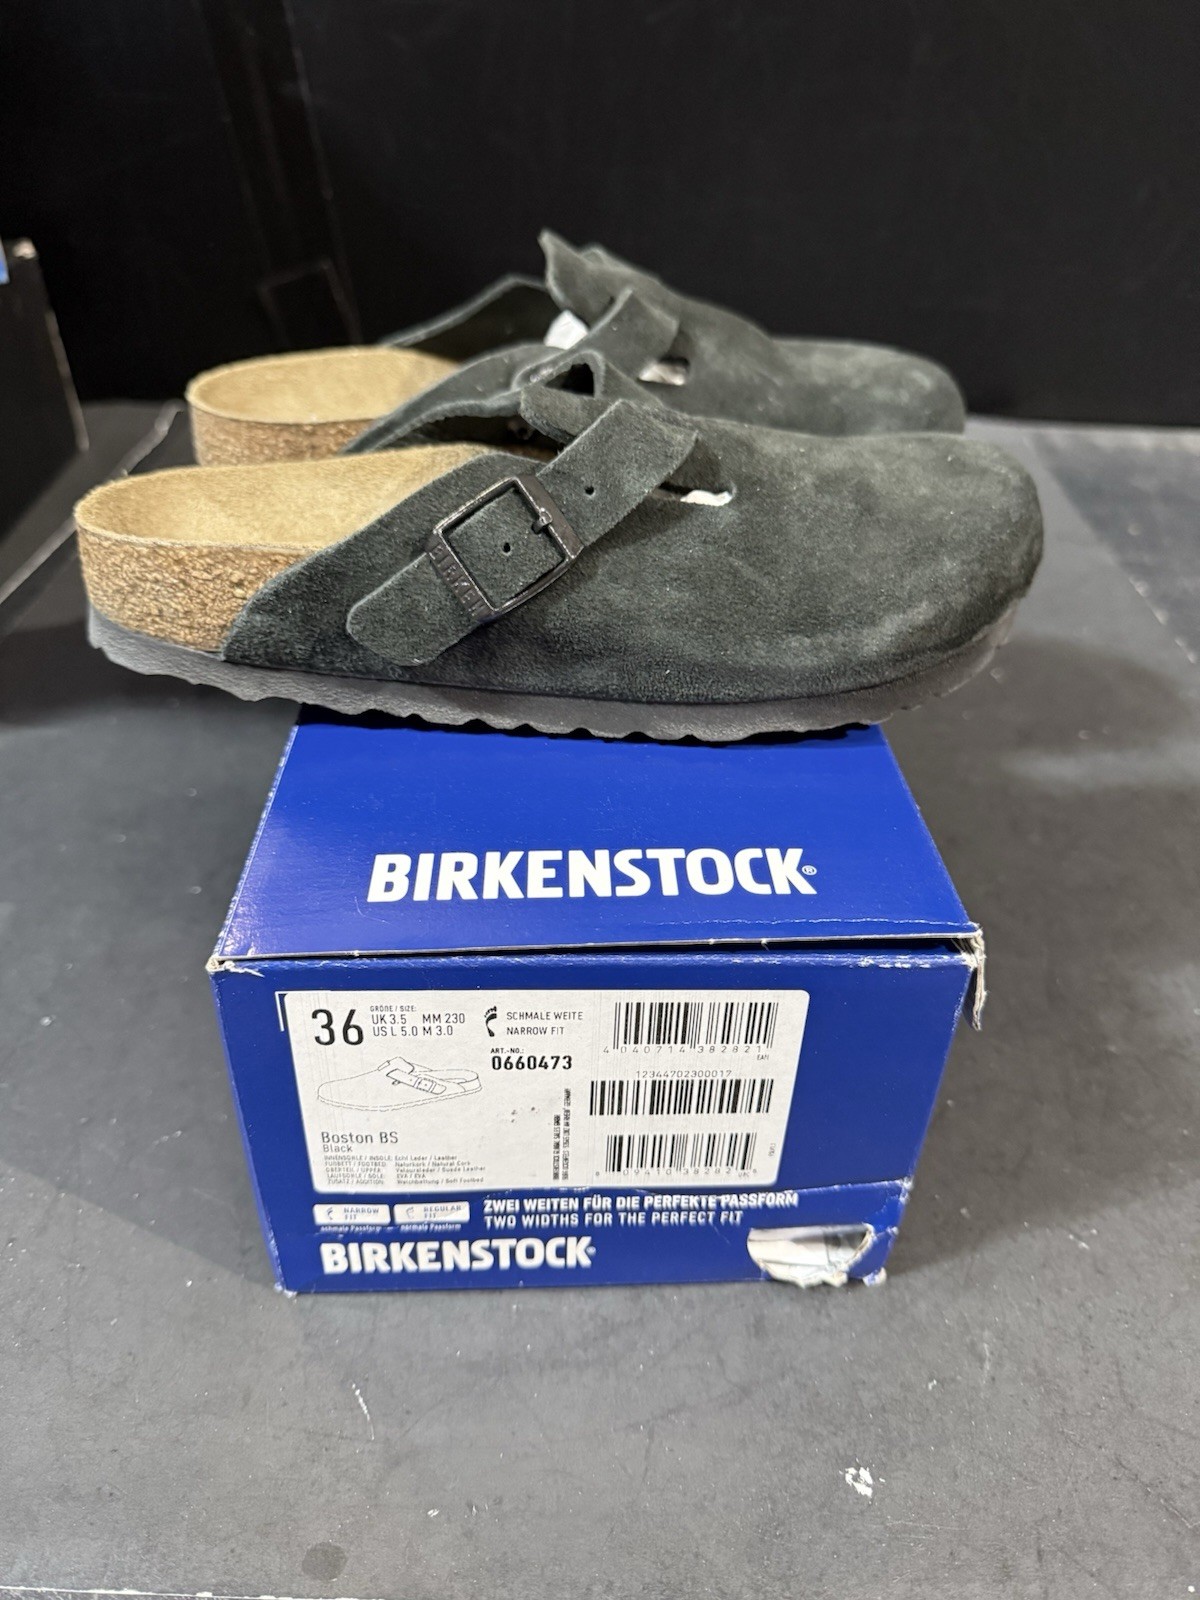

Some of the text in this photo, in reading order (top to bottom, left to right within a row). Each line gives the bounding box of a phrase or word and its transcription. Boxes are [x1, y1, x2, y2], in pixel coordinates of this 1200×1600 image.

[371, 1013, 466, 1025] UK 3.5 MM 230
[506, 1011, 584, 1021] SCHMALE WEITE
[311, 1008, 364, 1046] 36
[373, 1025, 454, 1037] US L 5.0 M 3.0
[506, 1026, 565, 1036] NARROW FIT
[602, 1046, 610, 1054] 4
[491, 1055, 573, 1071] 0660473
[636, 1069, 732, 1079] 12344702300017
[321, 1131, 399, 1144] Boston BS
[322, 1143, 353, 1153] Black
[484, 1190, 799, 1213] ZWEI WEITEN FÜR DIE PERFEKTE PASSFORM
[485, 1211, 744, 1229] TWO WIDTHS FOR THE PERFECT FIT
[320, 1236, 594, 1274] BIRKENSTOCK
